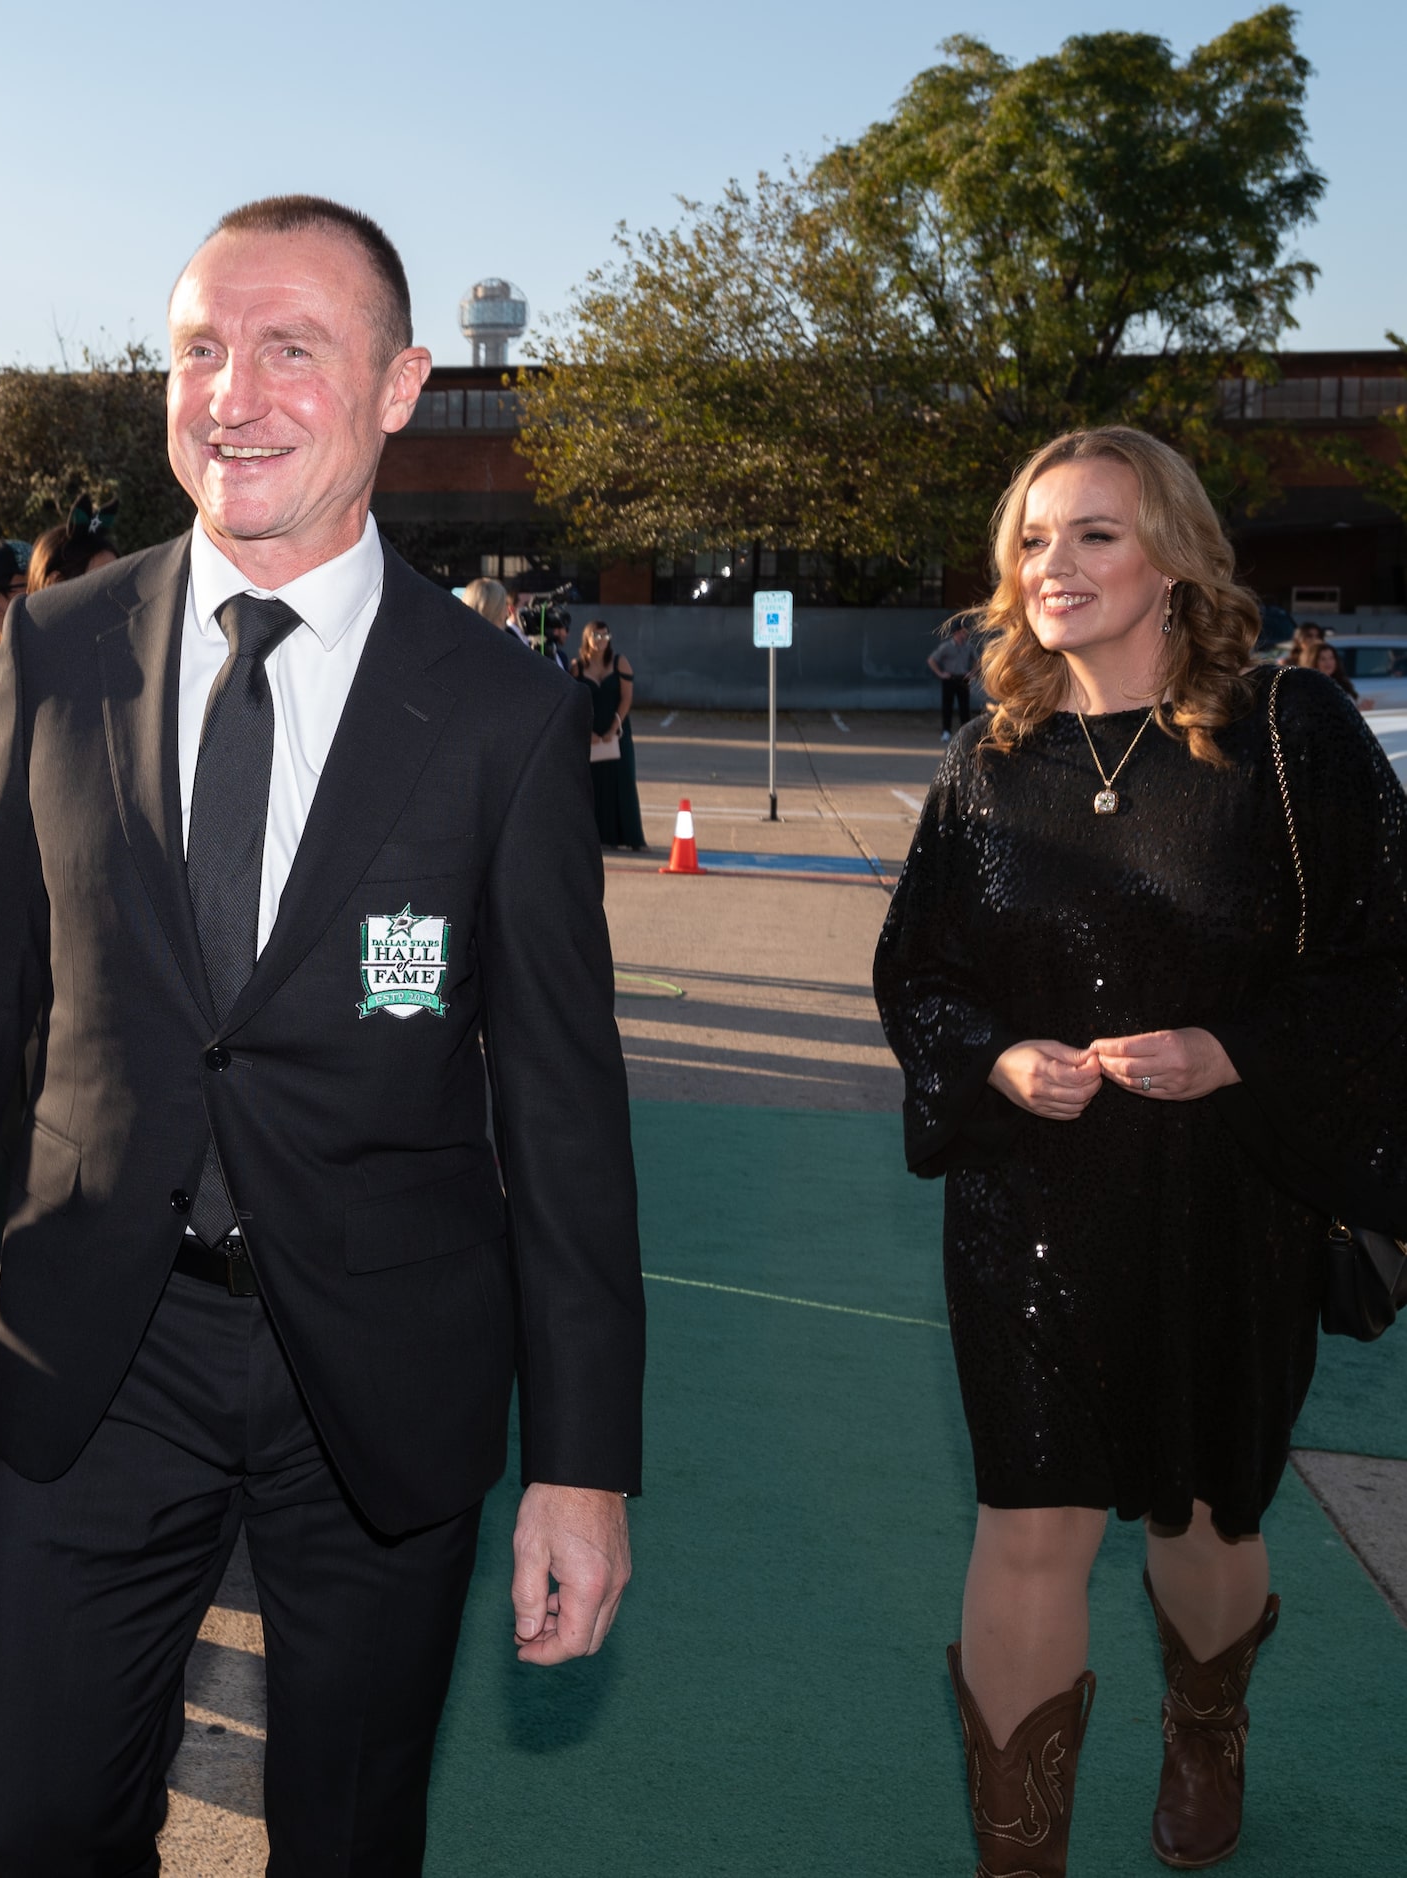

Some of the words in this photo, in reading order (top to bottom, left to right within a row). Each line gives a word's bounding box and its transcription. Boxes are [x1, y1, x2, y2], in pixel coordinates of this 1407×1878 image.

[371, 939, 408, 947] DALLAS
[410, 939, 440, 948] STARS
[374, 947, 436, 961] HALL
[396, 959, 413, 972] of
[374, 969, 435, 984] FAME
[408, 993, 433, 1005] 2022
